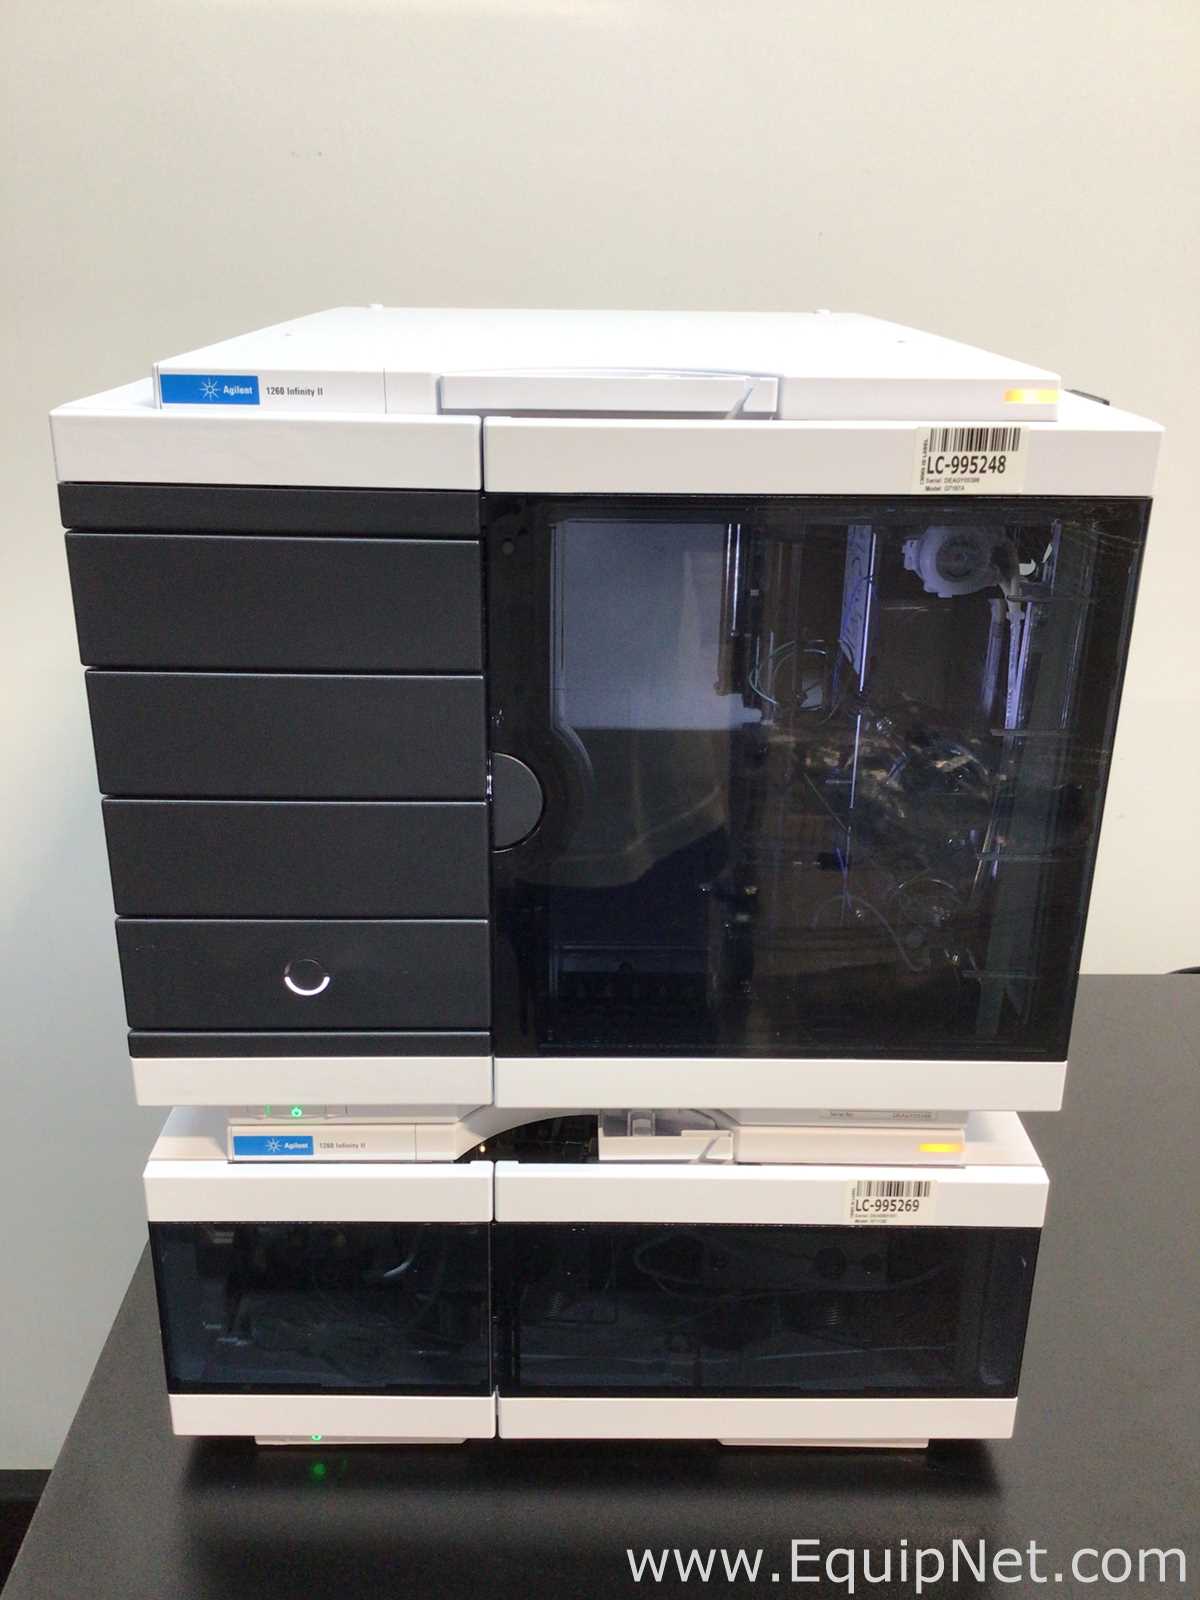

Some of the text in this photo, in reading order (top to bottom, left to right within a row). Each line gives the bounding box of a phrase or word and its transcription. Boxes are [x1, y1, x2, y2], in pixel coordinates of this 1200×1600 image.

[223, 385, 253, 396] Agilent
[286, 387, 315, 396] Infinity
[927, 455, 1007, 474] LC-995248
[284, 1141, 308, 1150] Agilent
[855, 1199, 920, 1212] LC-995269
